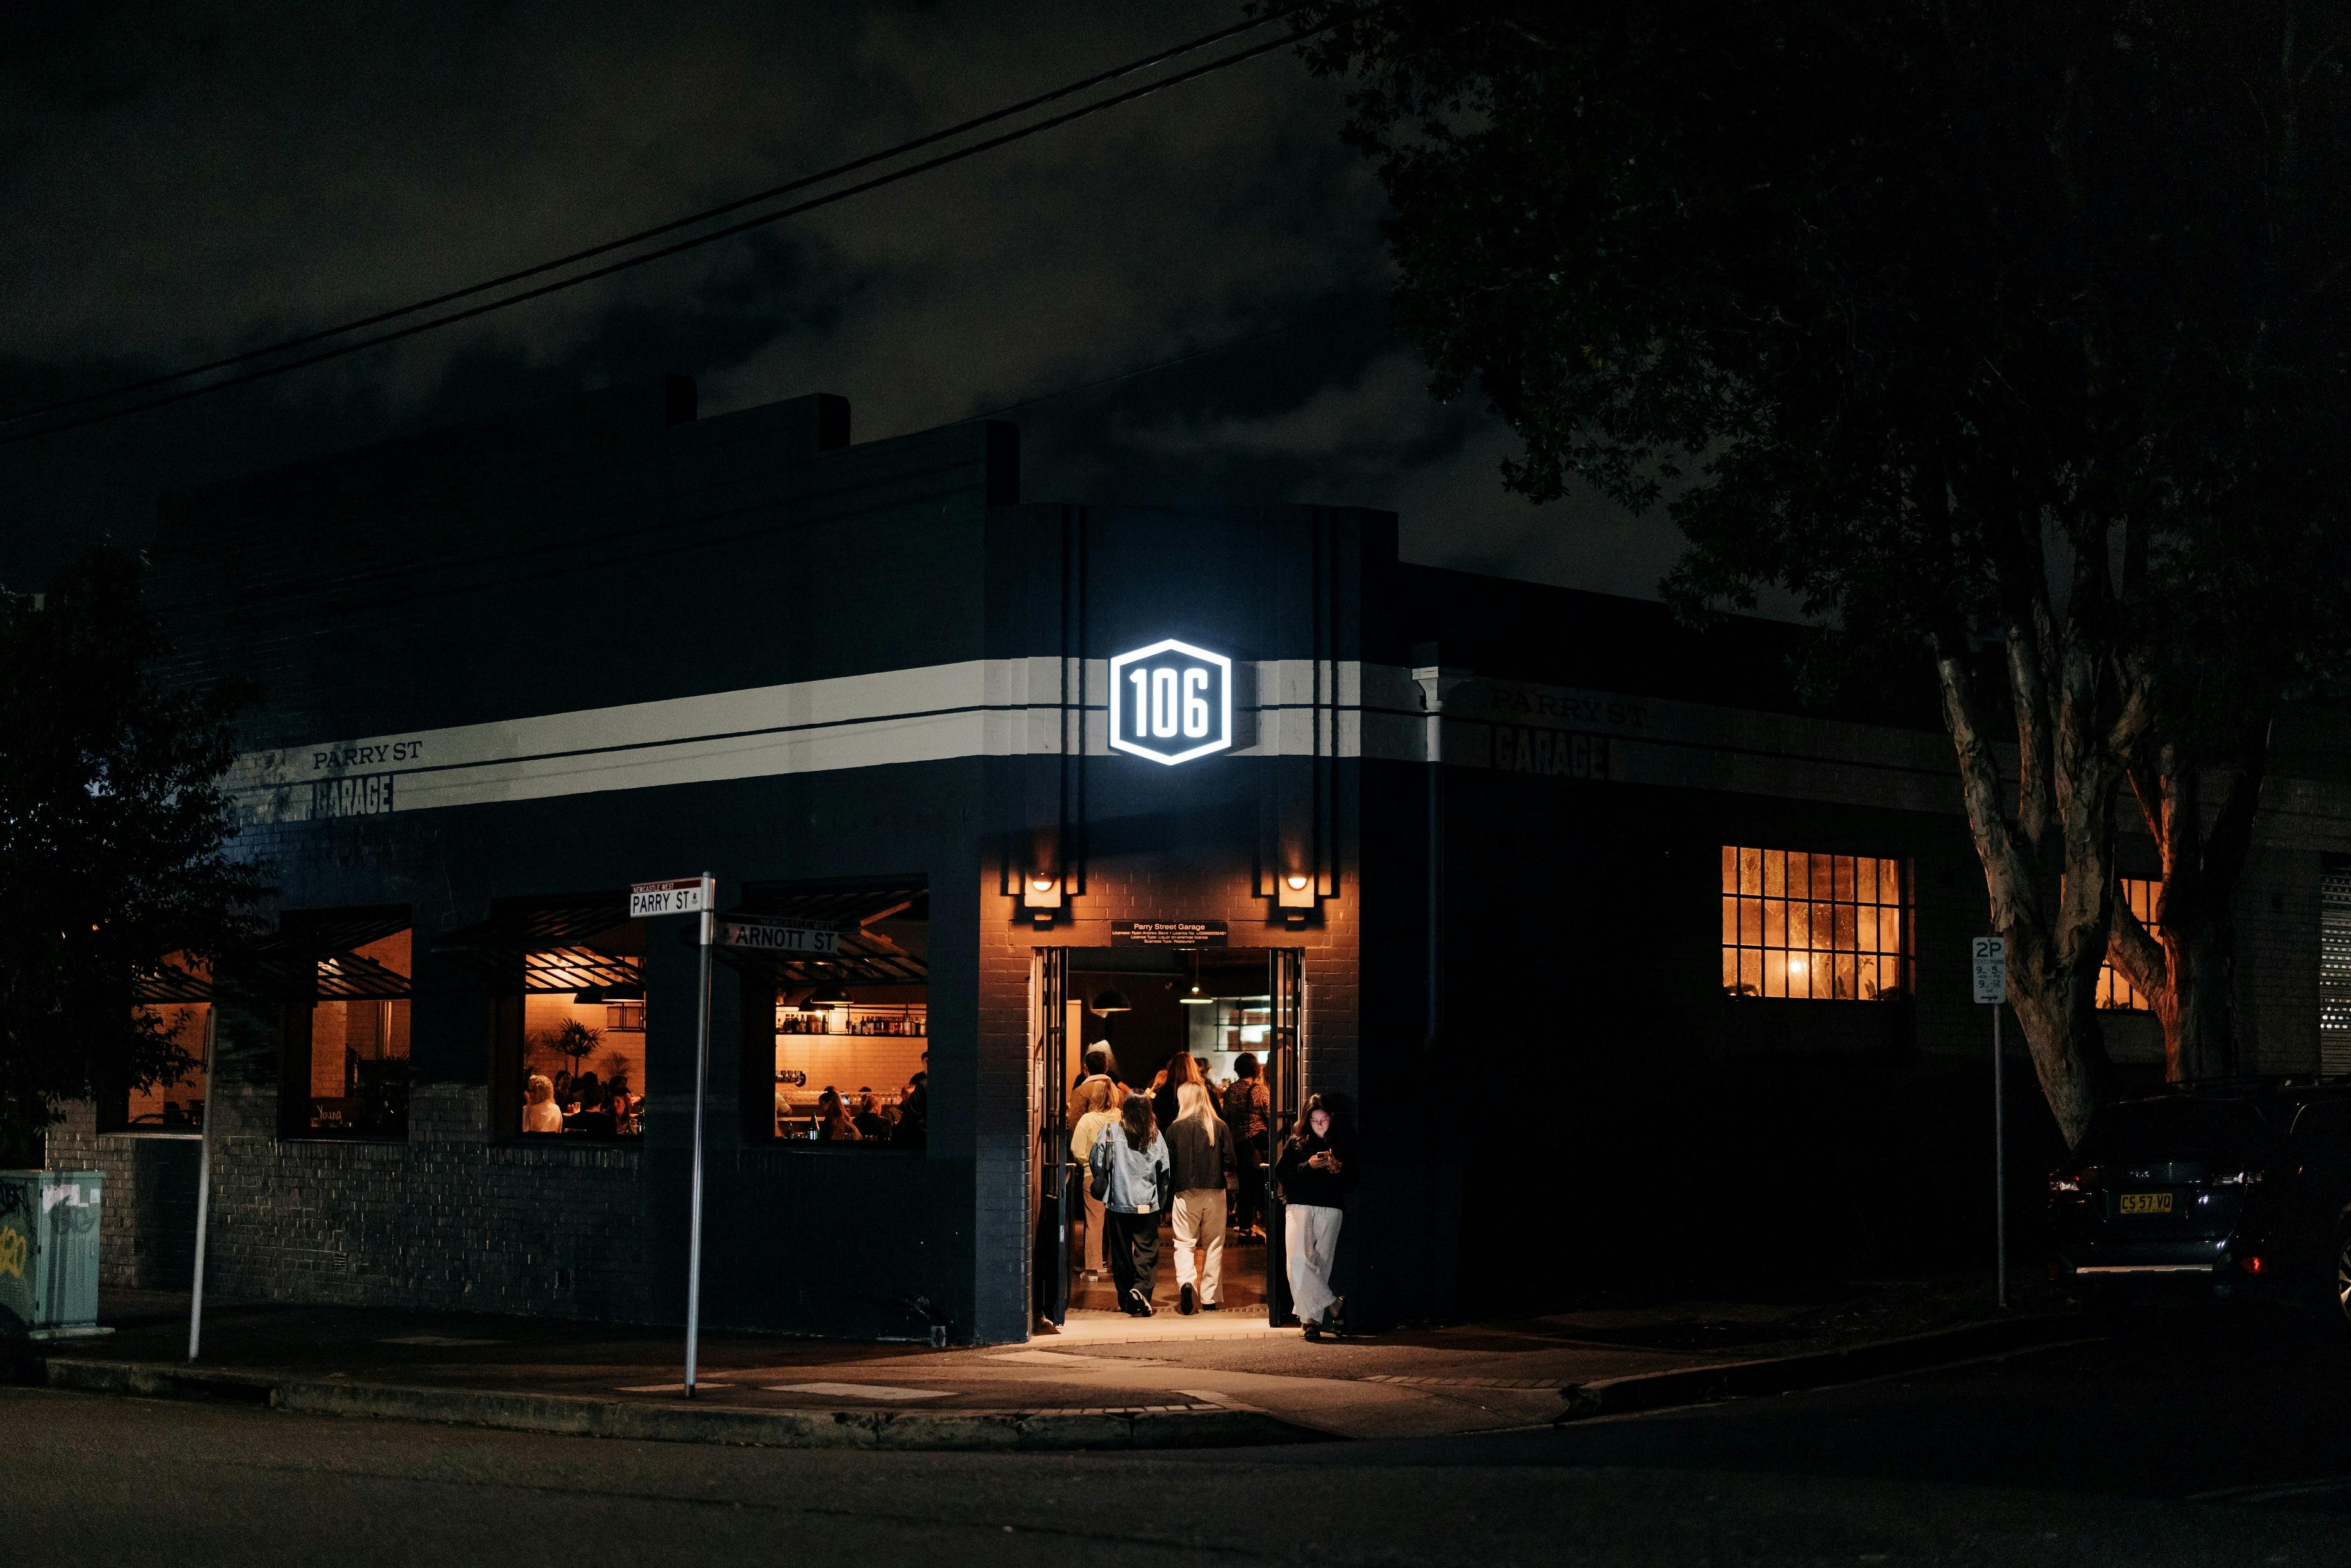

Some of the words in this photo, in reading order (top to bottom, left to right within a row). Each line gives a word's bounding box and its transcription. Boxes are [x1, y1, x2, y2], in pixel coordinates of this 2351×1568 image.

[1130, 667, 1208, 738] 106
[1492, 689, 1601, 722] PARRY
[1608, 704, 1647, 726] ST
[313, 744, 390, 770] PARRY
[393, 741, 422, 760] ST
[1495, 726, 1606, 780] GARAGE
[633, 884, 660, 893] NEWCASTLE
[633, 893, 670, 913] PARRY
[676, 891, 689, 909] ST
[735, 926, 805, 948] ARNOTT
[814, 932, 835, 951] ST
[1977, 942, 2001, 957] 2P
[316, 1104, 342, 1125] Young
[2122, 1196, 2135, 1209] CS
[2139, 1196, 2153, 1209] 57
